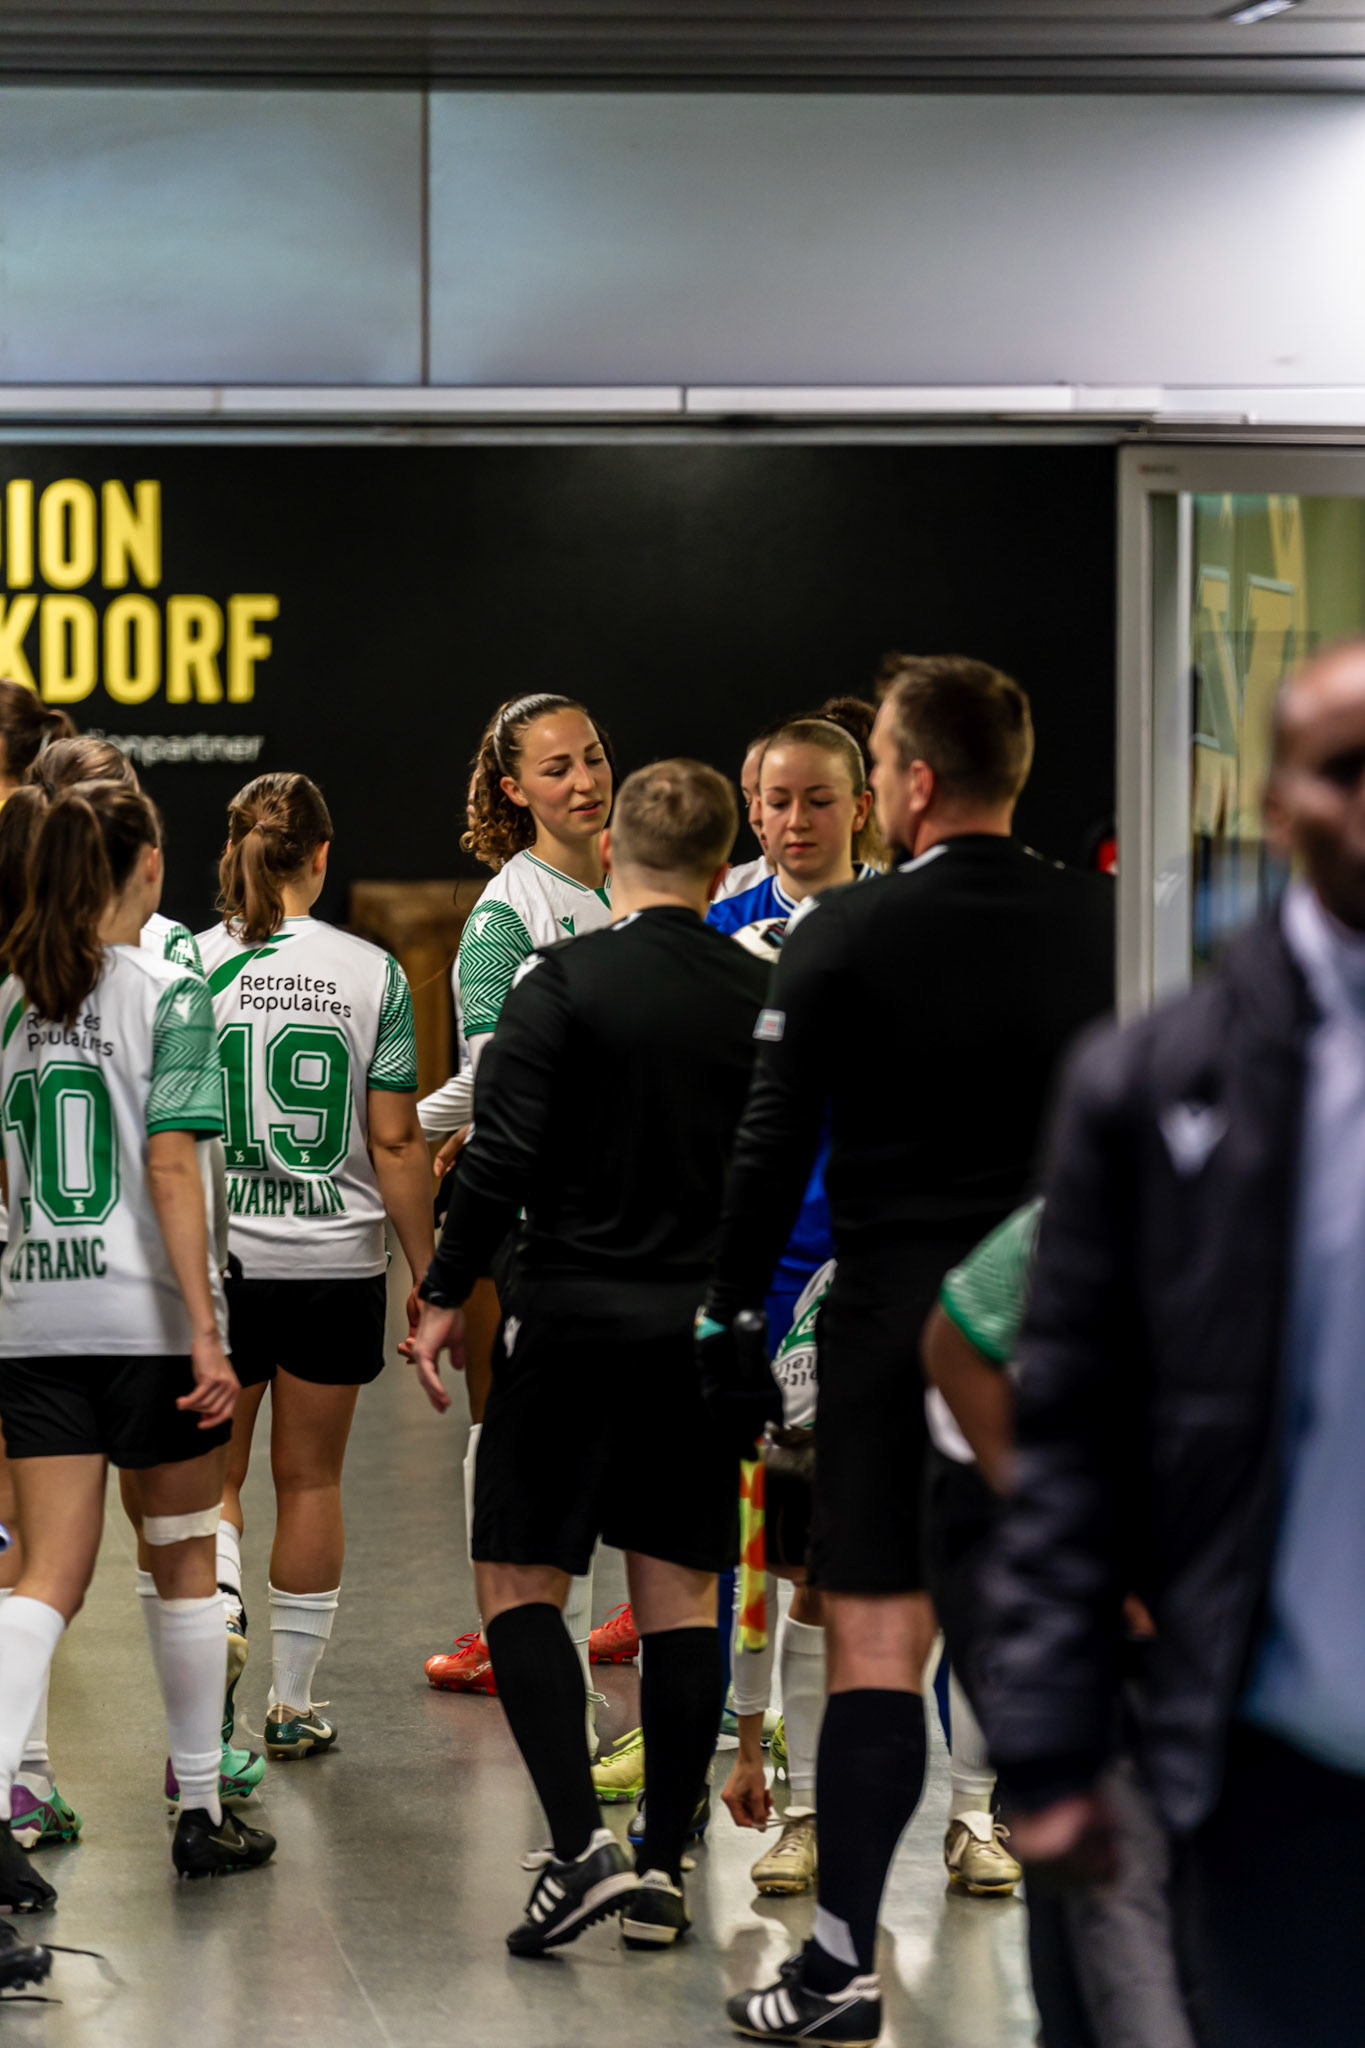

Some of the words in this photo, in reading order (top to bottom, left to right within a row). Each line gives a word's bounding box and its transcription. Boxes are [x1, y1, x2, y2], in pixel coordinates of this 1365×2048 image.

[0, 479, 162, 589] ION
[240, 974, 337, 995] Retraites
[240, 994, 352, 1018] Populaires
[218, 1022, 353, 1174] 19
[4, 1060, 120, 1227] 10
[9, 1236, 107, 1283] FRANC
